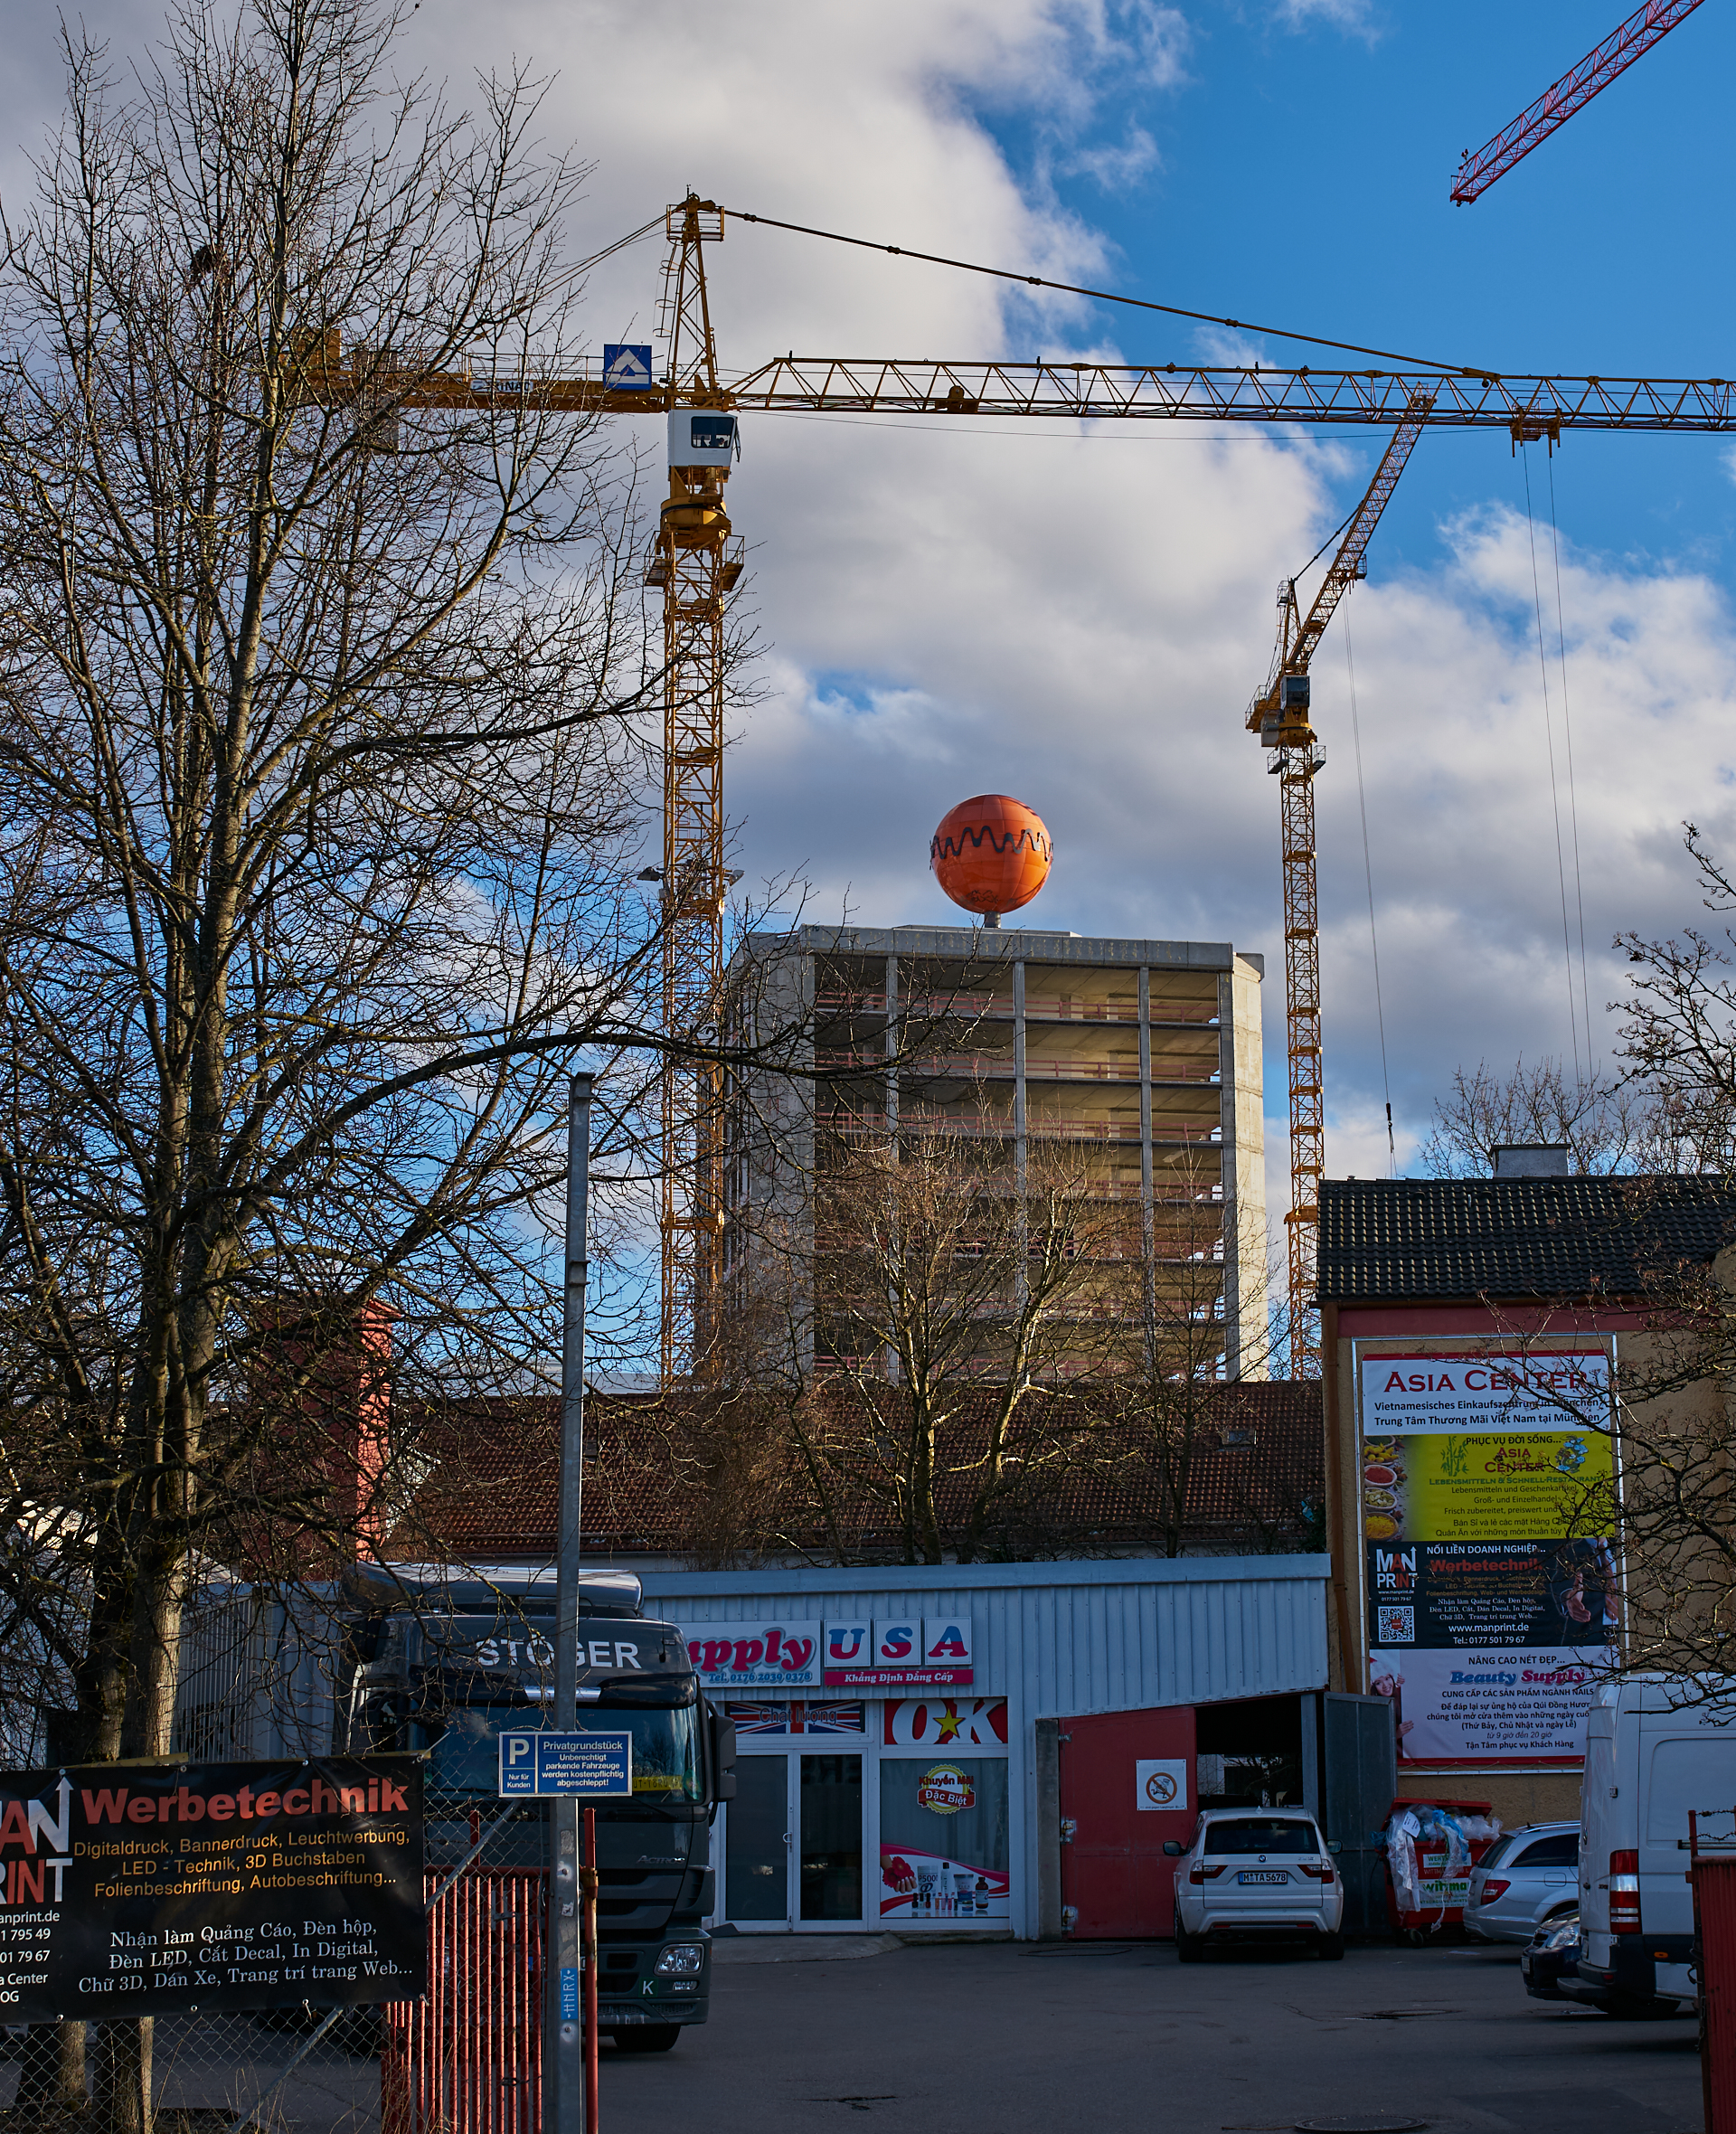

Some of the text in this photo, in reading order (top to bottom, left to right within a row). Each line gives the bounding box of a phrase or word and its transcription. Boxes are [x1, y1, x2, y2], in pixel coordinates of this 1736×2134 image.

[1374, 1402, 1455, 1412] Vietnamesisches
[1374, 1417, 1402, 1427] Trung
[1405, 1416, 1426, 1425] Tâm
[1514, 1414, 1535, 1422] Nam
[1467, 1545, 1501, 1553] DOANH
[1376, 1546, 1417, 1572] MAN
[1377, 1572, 1418, 1589] PRINT
[1448, 1622, 1529, 1633] www.manprint.de
[1489, 1636, 1503, 1644] 501
[1468, 1655, 1495, 1665] NÂNG
[1498, 1657, 1517, 1665] CAO
[1520, 1655, 1536, 1664] NÉT
[708, 1672, 812, 1683] Tel. 0176 2039 0378
[1449, 1668, 1585, 1685] Beauty Supply
[509, 1738, 530, 1764] P
[543, 1742, 623, 1752] Privatgrundstück
[559, 1753, 608, 1762] Unberechtigt
[545, 1762, 620, 1771] parkende Fahrzeuge
[521, 1772, 530, 1780] für
[542, 1770, 625, 1779] werden kostenpflichtig
[557, 1779, 609, 1788] abgeschleppt!
[81, 1777, 410, 1825] Werbetechnik
[74, 1828, 410, 1860] Digitaldruck, Bannerdruck, Leuchtwerbung,
[122, 1851, 366, 1876] LED Technik, 3D Buchstaben
[1255, 1873, 1265, 1882] TA
[1266, 1873, 1286, 1882] 5678
[94, 1871, 397, 1898] Folienbeschriftung, Autobeschriftung...
[11, 1930, 33, 1942] 795
[35, 1928, 52, 1940] 49
[109, 1918, 378, 1950] Nhận làm Quảng Cáo, Đèn hộp,
[18, 1951, 33, 1963] 79
[35, 1950, 51, 1962] 67
[108, 1940, 379, 1970] Đèn LED, Cắt Decal, In Digital,
[7, 1972, 49, 1987] Center
[78, 1959, 413, 1994] Chữ 3D, Dán Xe, Trang trí trang Web...
[642, 1980, 654, 1995] K
